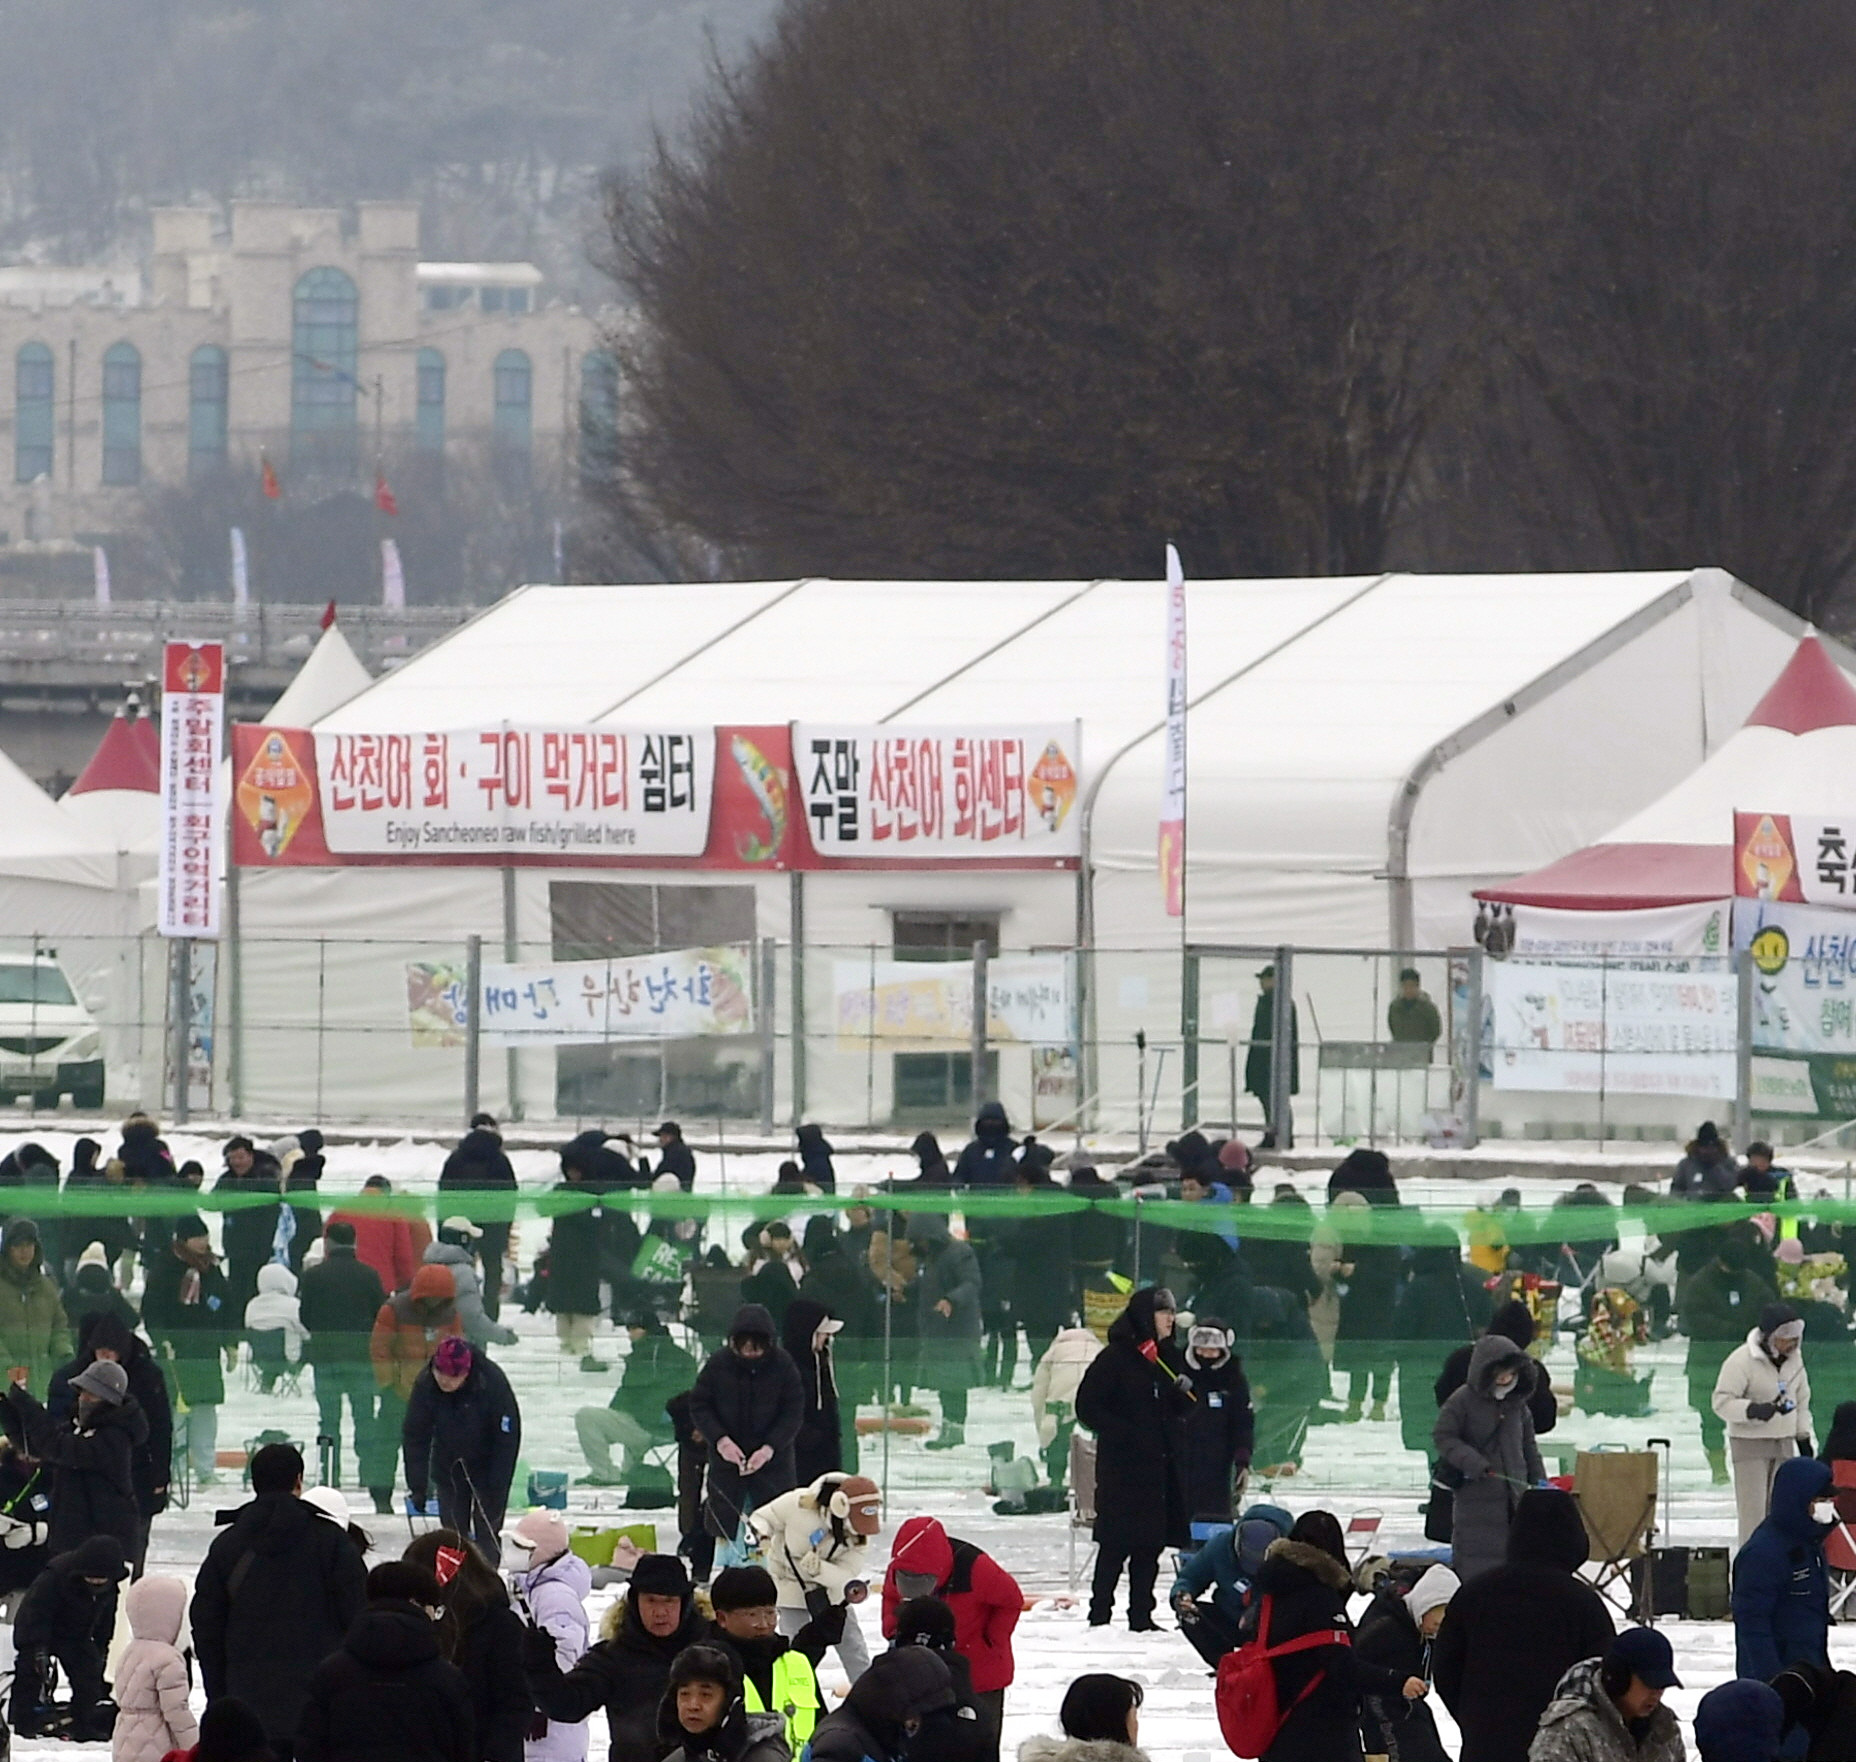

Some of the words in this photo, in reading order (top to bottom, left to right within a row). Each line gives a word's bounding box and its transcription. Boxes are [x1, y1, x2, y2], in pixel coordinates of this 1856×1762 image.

[331, 734, 411, 811] 산천어
[424, 733, 448, 810] 회
[478, 731, 531, 812] 구이
[543, 733, 629, 812] 먹거리
[640, 734, 695, 813] 쉼터
[810, 739, 859, 841] 주말
[869, 738, 943, 841] 산천어
[953, 738, 1026, 841] 회센터
[387, 820, 420, 849] Enjoy
[501, 824, 526, 843] raw
[604, 823, 636, 845] here
